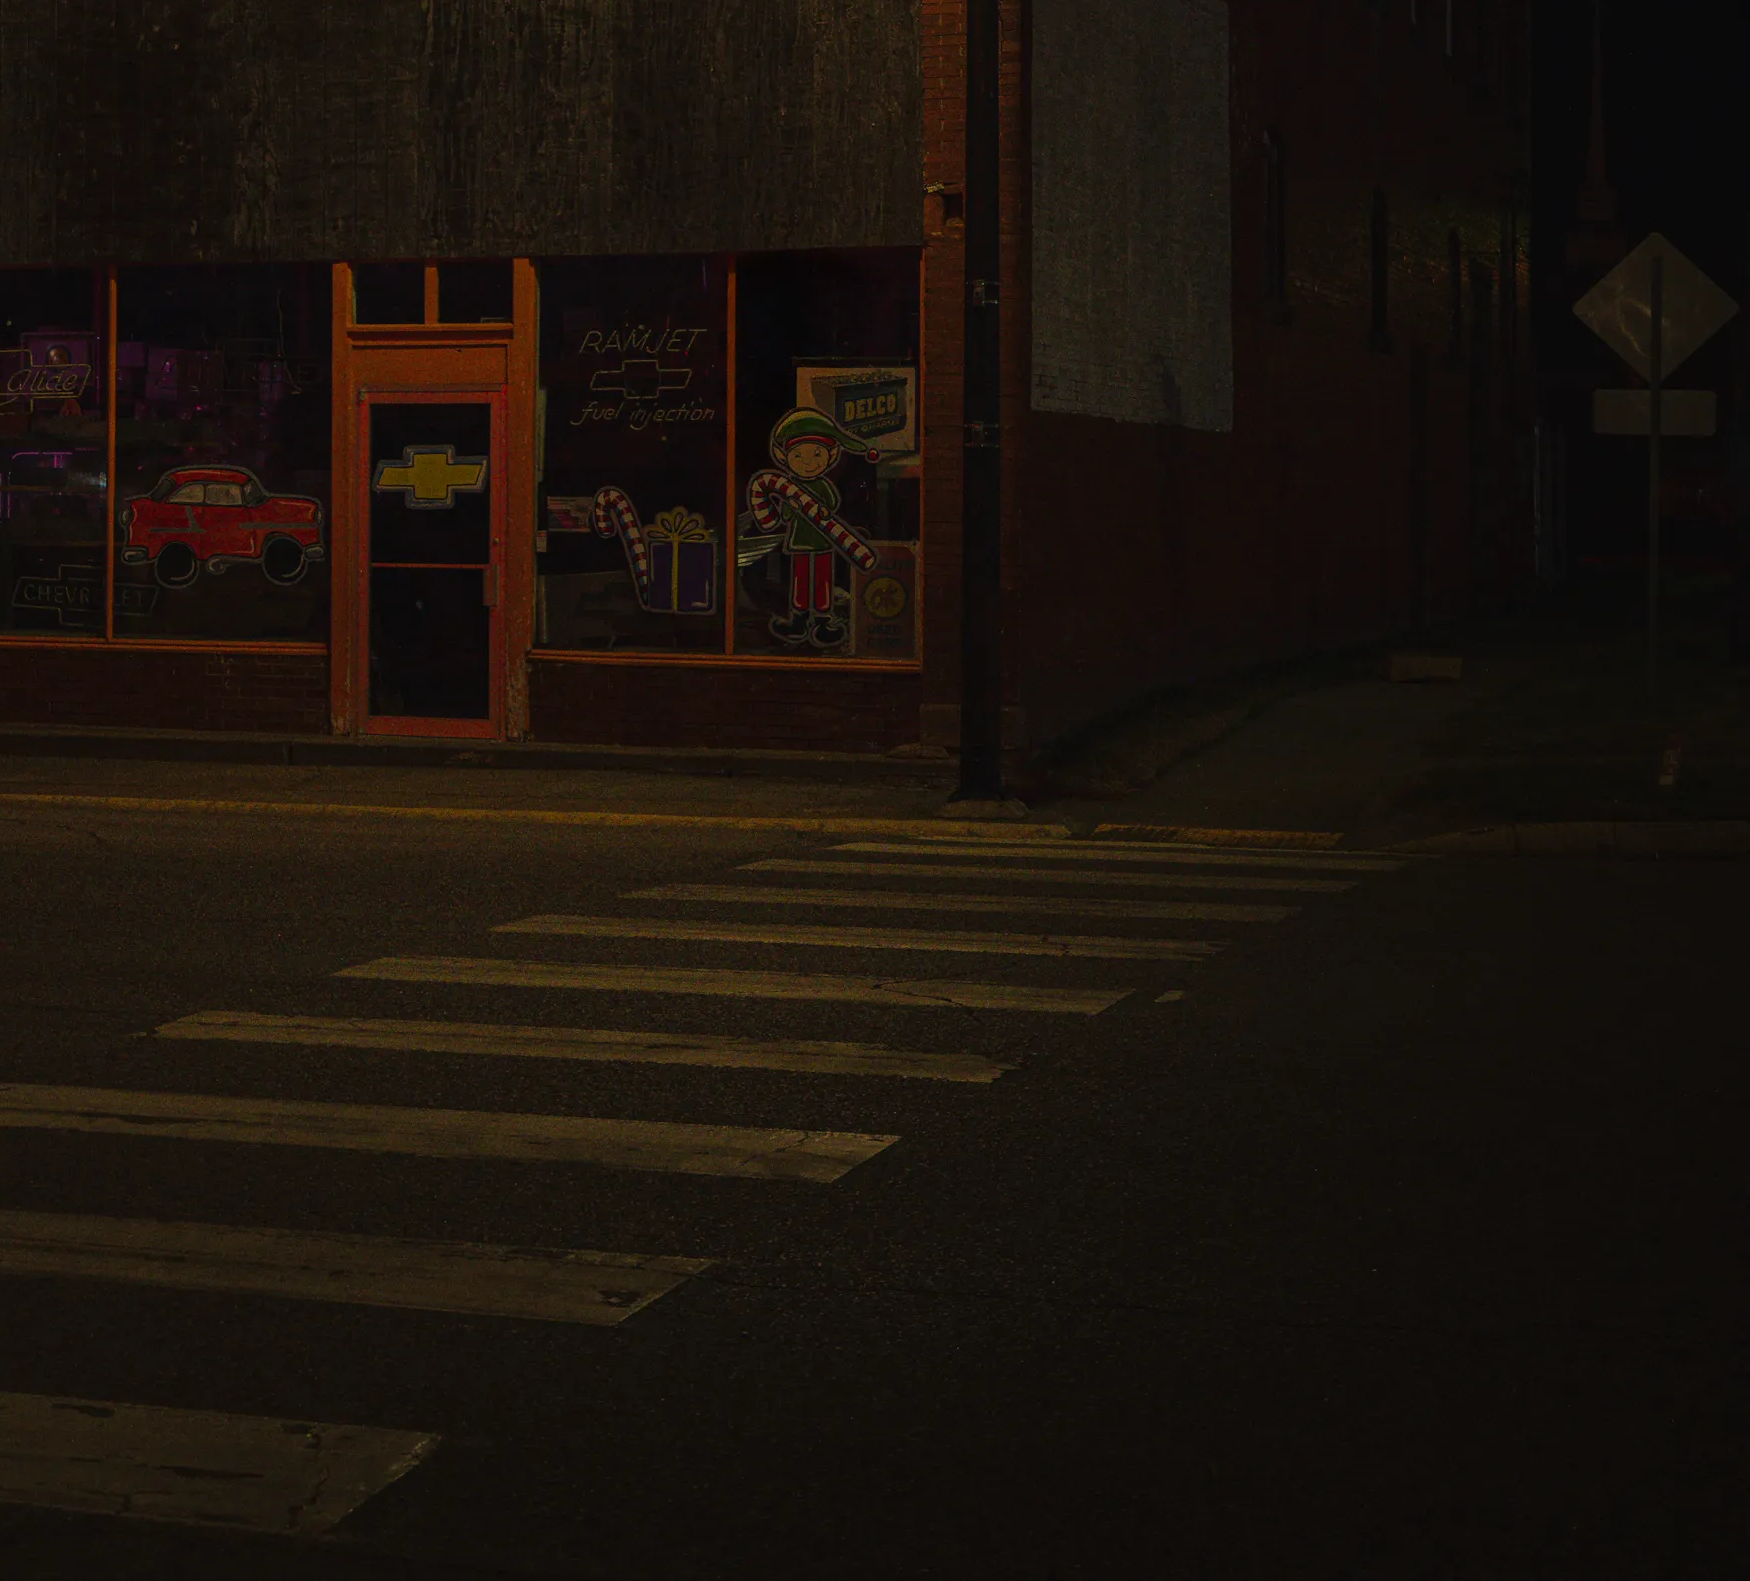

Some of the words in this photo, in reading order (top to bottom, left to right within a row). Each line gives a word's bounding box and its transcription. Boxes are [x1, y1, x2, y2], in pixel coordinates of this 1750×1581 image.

[578, 328, 708, 355] RAMJET
[569, 401, 626, 426] fuel
[629, 397, 716, 431] injection
[844, 393, 898, 423] DELCO
